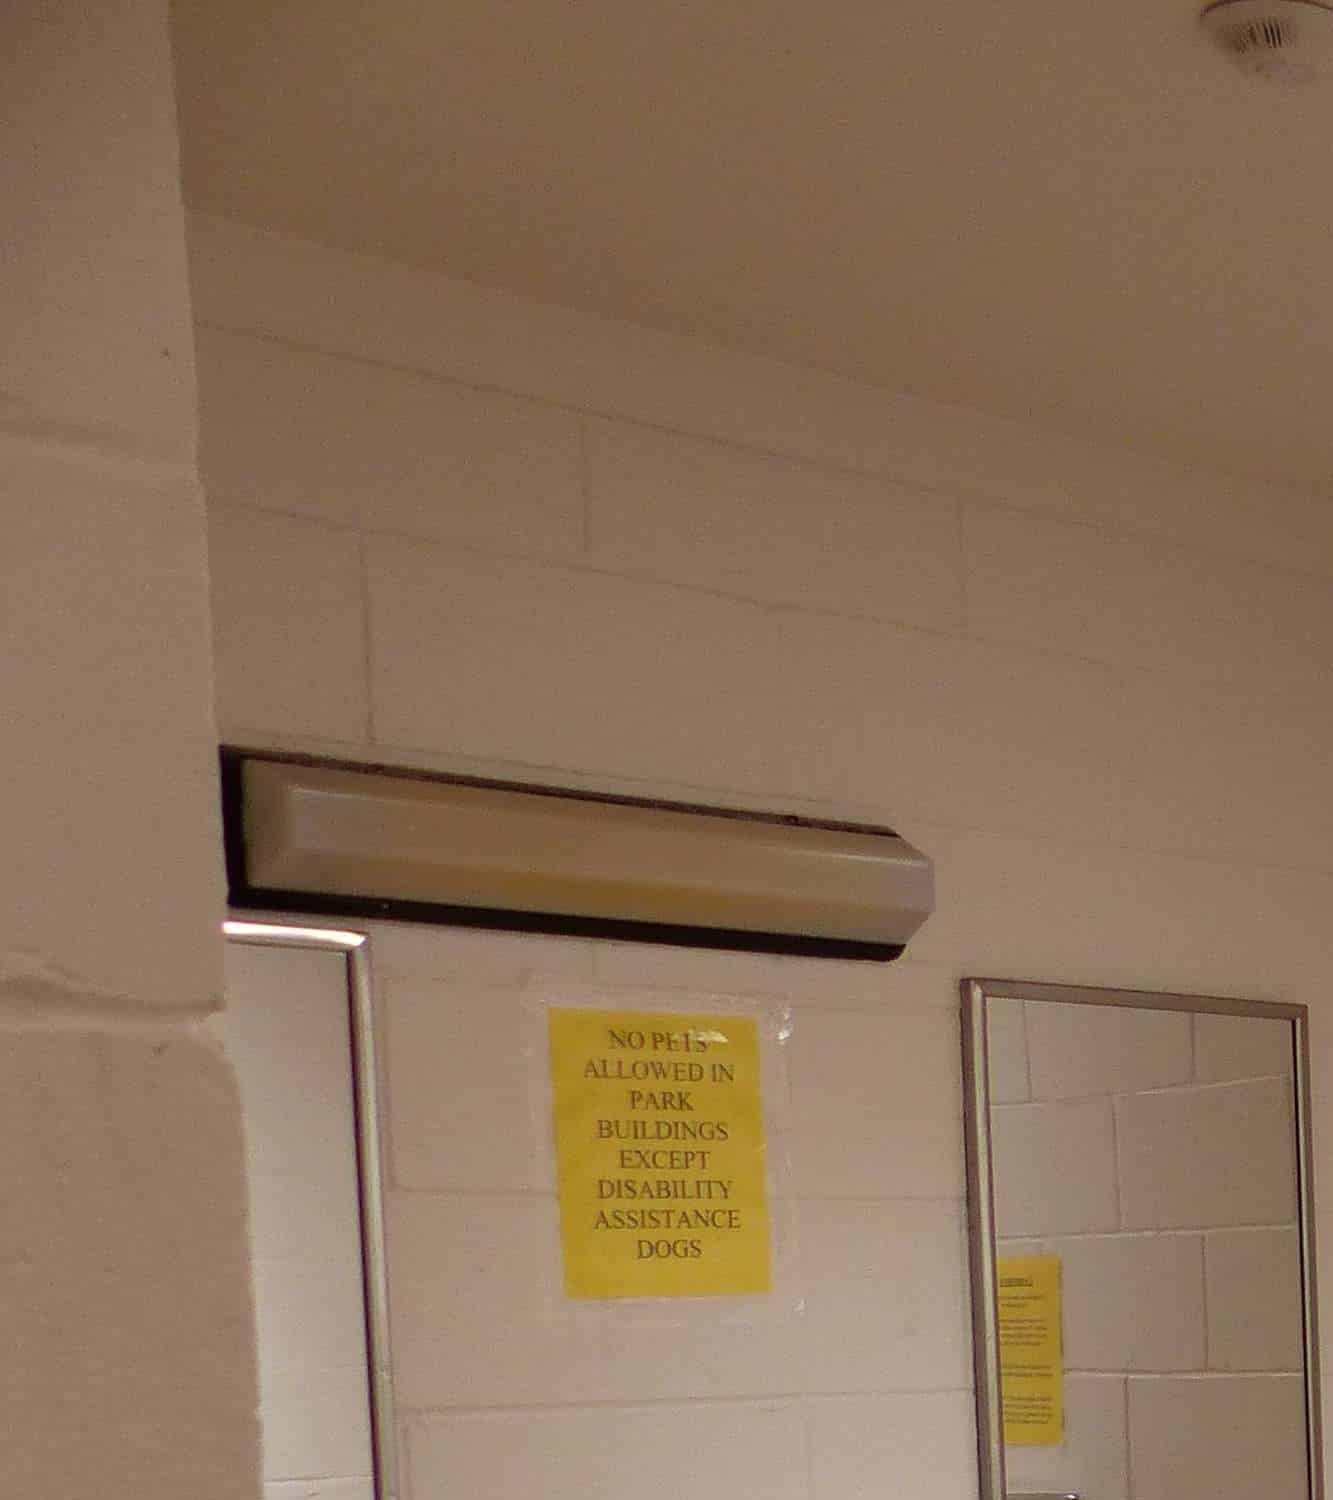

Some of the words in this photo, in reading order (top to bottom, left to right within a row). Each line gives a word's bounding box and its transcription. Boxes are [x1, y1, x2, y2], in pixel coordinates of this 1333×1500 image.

[608, 1030, 646, 1050] NO
[651, 1031, 710, 1053] PETS
[583, 1060, 704, 1082] ALLOWED
[711, 1063, 735, 1083] IN
[629, 1090, 694, 1111] PARK
[597, 1119, 729, 1141] BUILDINGS
[619, 1149, 711, 1170] EXCEPT
[596, 1179, 735, 1200] DISABILITY
[593, 1209, 742, 1230] ASSISTANCE
[636, 1239, 703, 1259] DOGS
